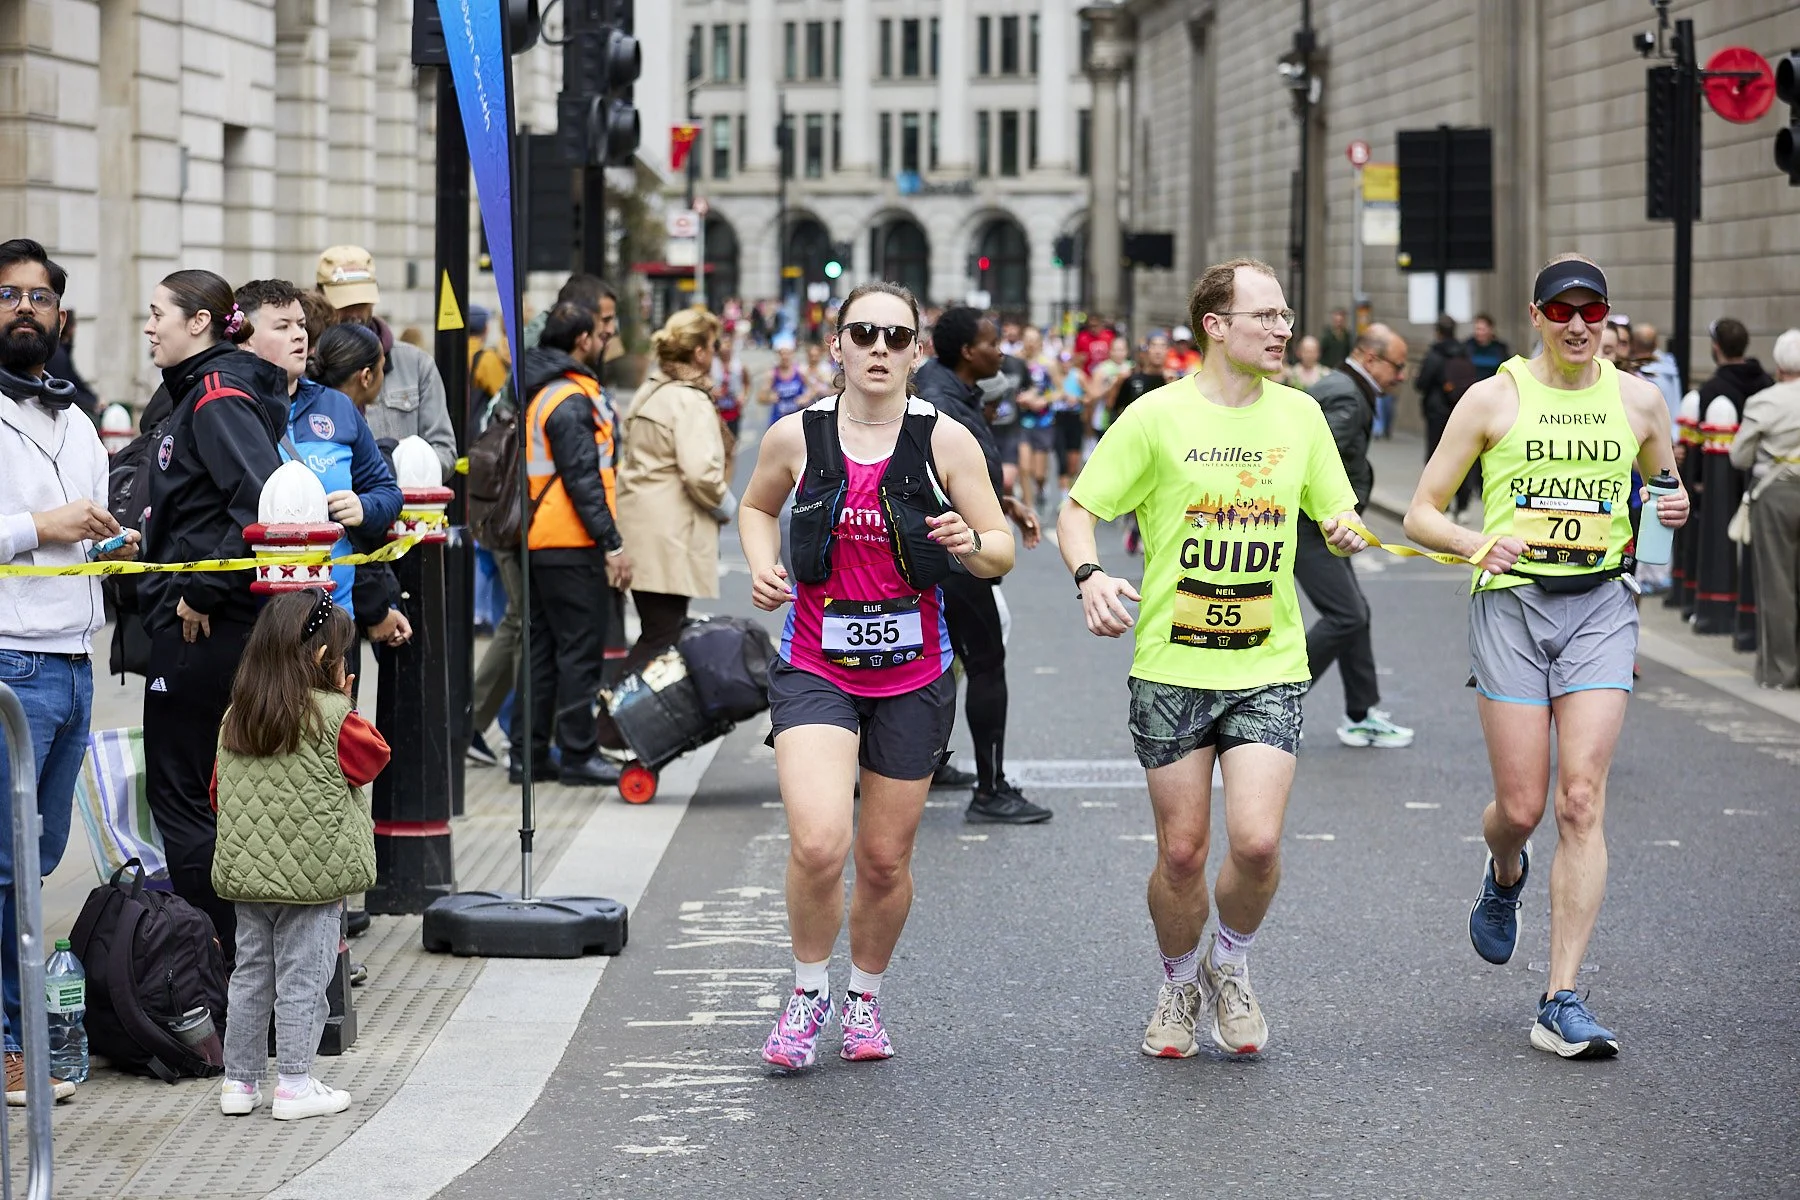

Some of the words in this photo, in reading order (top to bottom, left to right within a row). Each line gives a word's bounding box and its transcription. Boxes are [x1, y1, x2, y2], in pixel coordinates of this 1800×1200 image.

[1539, 413, 1607, 425] ANDREW
[1183, 447, 1263, 462] Achilles
[1526, 439, 1621, 462] BLIND
[1510, 477, 1623, 503] RUNNER
[792, 500, 823, 514] ALOMON
[1547, 516, 1582, 542] 70
[1180, 537, 1284, 573] GUIDE
[1215, 588, 1236, 596] NEIL
[863, 604, 882, 613] ELLIE
[1205, 603, 1242, 627] 55
[846, 619, 900, 646] 355
